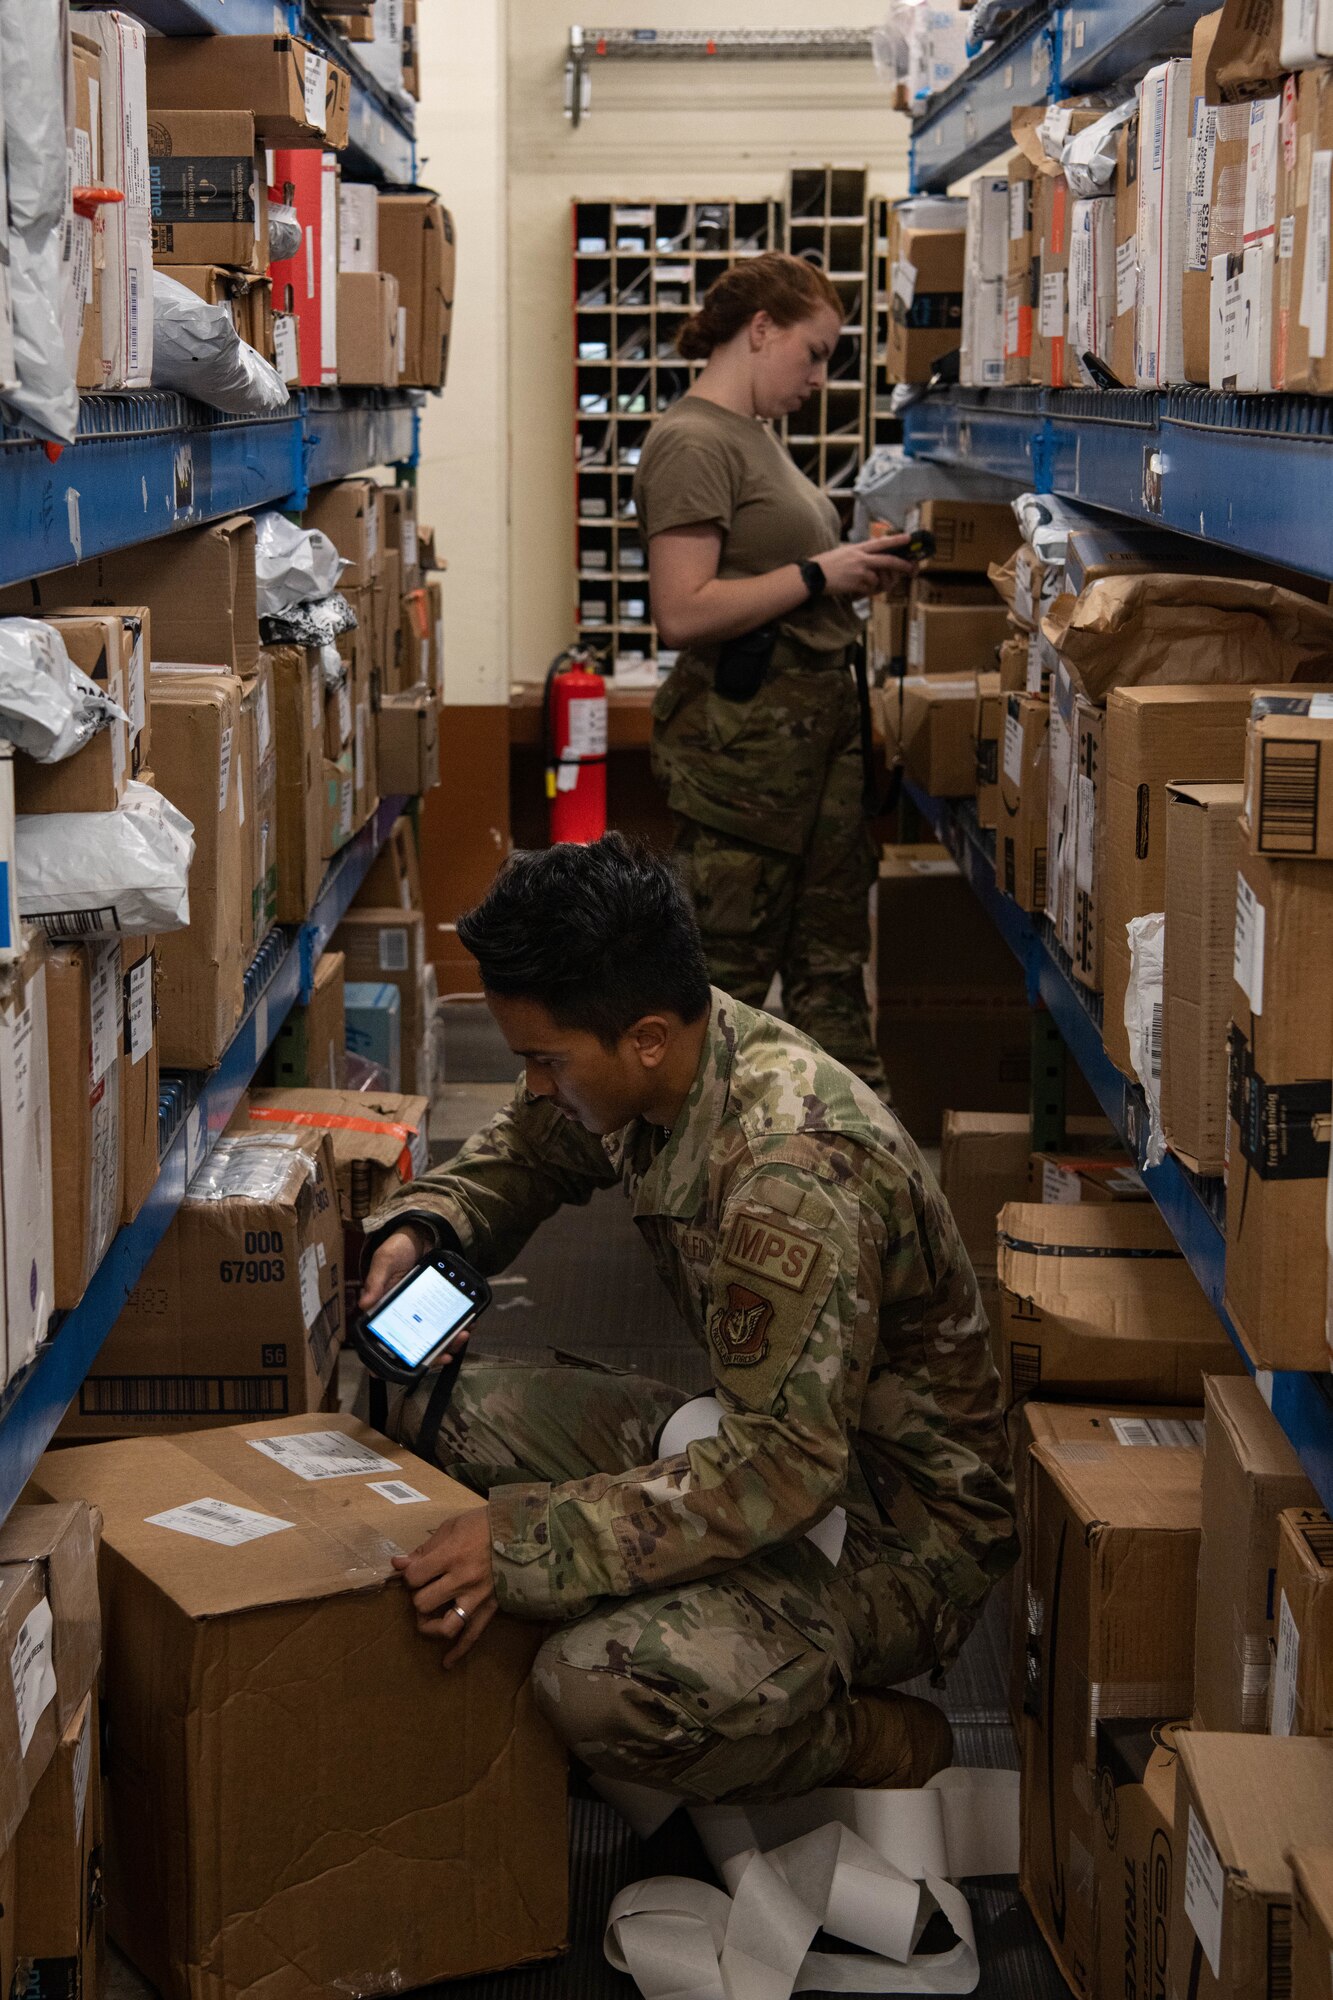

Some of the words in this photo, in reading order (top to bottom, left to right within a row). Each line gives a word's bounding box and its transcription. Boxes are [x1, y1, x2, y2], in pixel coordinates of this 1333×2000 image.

[187, 165, 195, 182] free
[236, 162, 245, 183] video
[149, 166, 165, 217] prime
[187, 183, 196, 218] listening
[236, 184, 245, 220] streaming
[1199, 203, 1210, 267] 04153
[1266, 1093, 1279, 1141] listening
[1266, 1143, 1278, 1167] free
[734, 1223, 808, 1279] MPS
[220, 1259, 286, 1284] 67903
[264, 1348, 284, 1364] 56
[733, 1354, 757, 1363] FORCES
[1124, 1856, 1137, 2000] TRIKE
